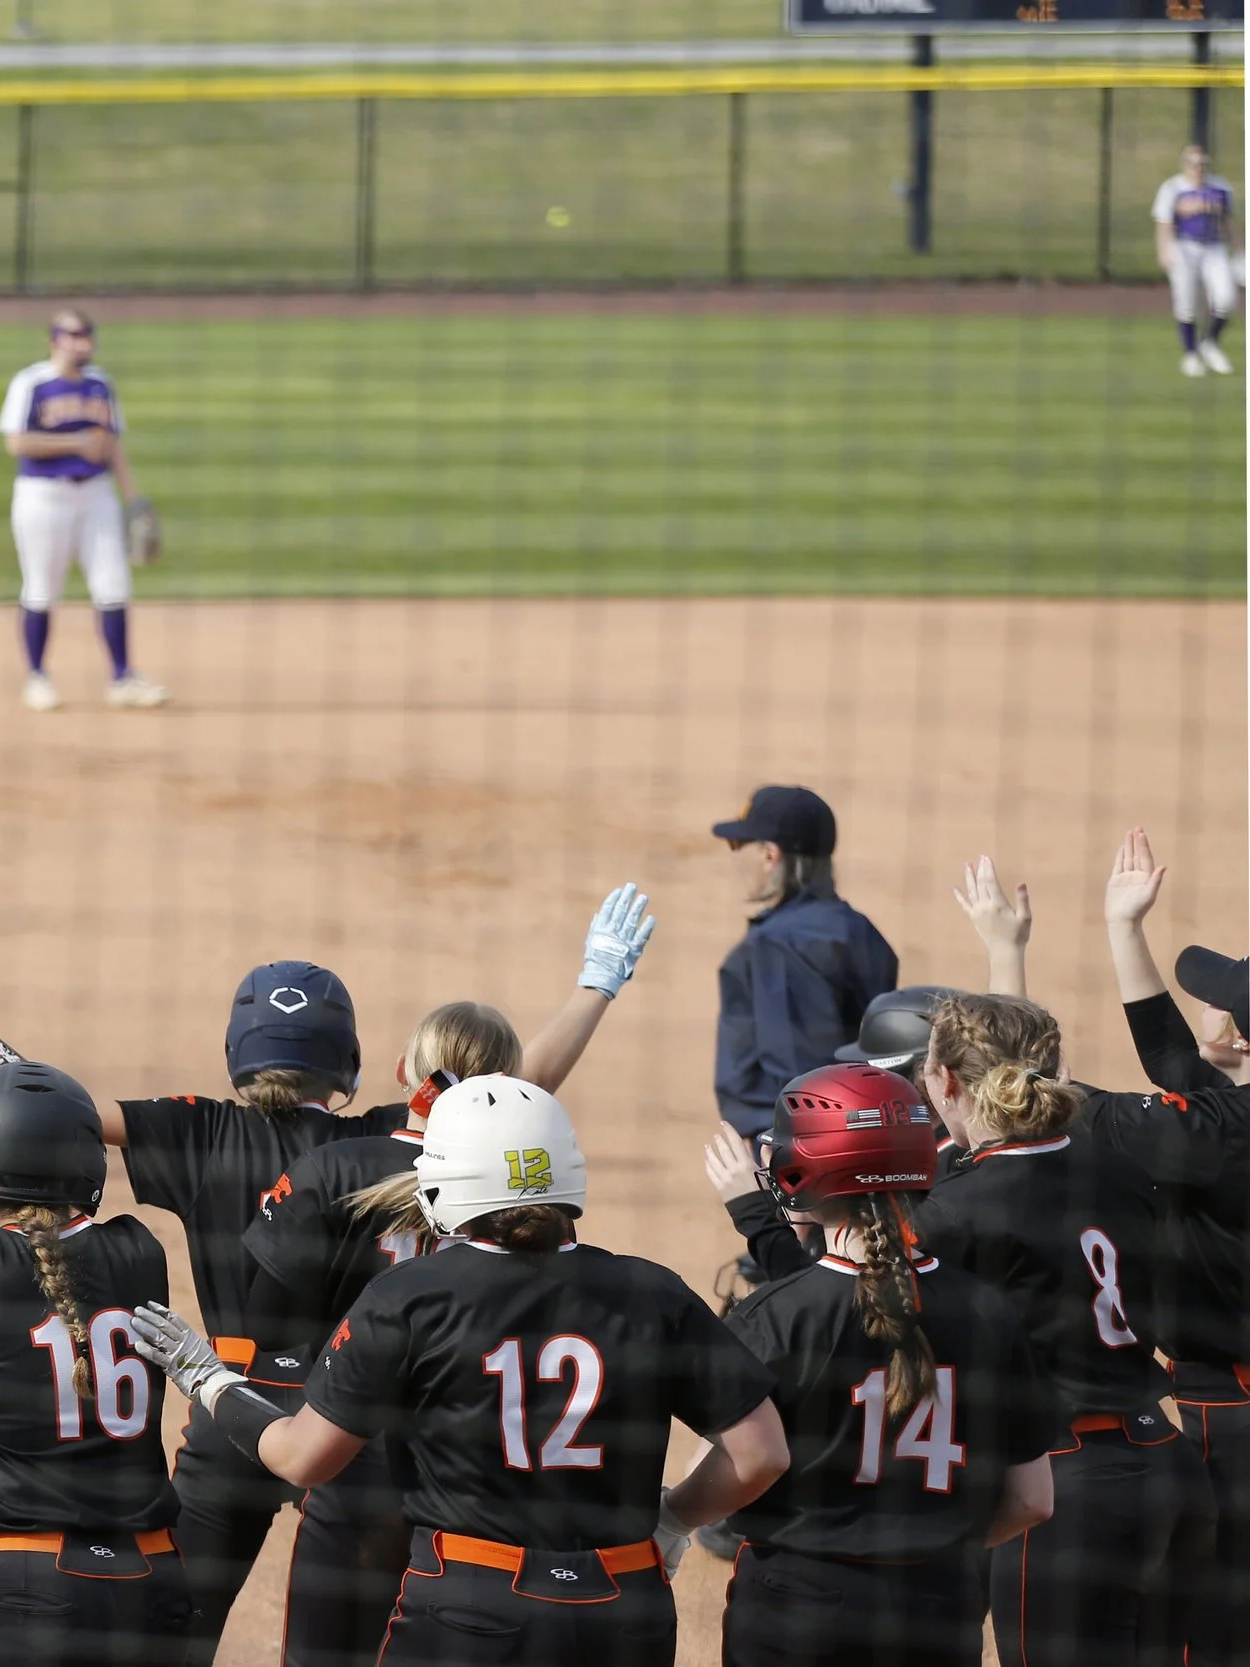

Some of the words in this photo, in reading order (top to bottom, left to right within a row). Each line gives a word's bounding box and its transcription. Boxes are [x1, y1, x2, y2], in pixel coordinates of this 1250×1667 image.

[503, 1147, 553, 1190] 12
[885, 1174, 928, 1182] BOOMBAH
[1078, 1225, 1139, 1350] 8
[30, 1307, 150, 1441] 16
[482, 1333, 605, 1472] 12
[851, 1364, 967, 1494] 14
